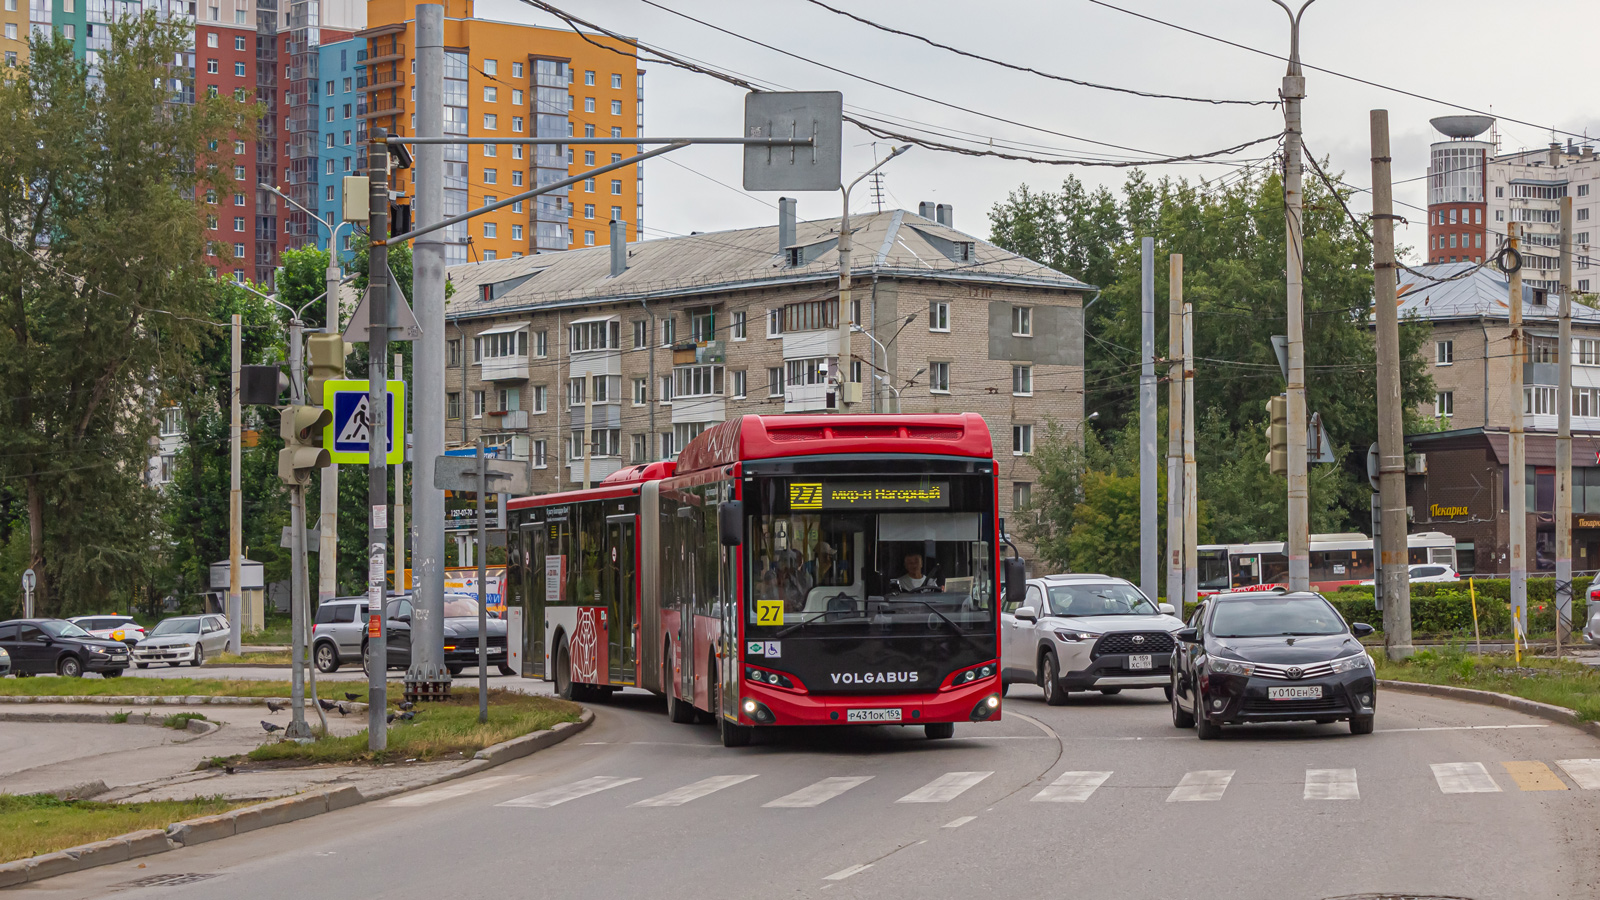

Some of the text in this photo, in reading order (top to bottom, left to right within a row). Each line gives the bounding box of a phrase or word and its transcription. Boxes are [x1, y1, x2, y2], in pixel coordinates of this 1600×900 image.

[791, 485, 820, 506] 27
[832, 486, 941, 503] мкр-н Нагорный
[1430, 503, 1469, 520] Пекарня
[760, 605, 781, 622] 27
[830, 671, 919, 684] VOLGABUS
